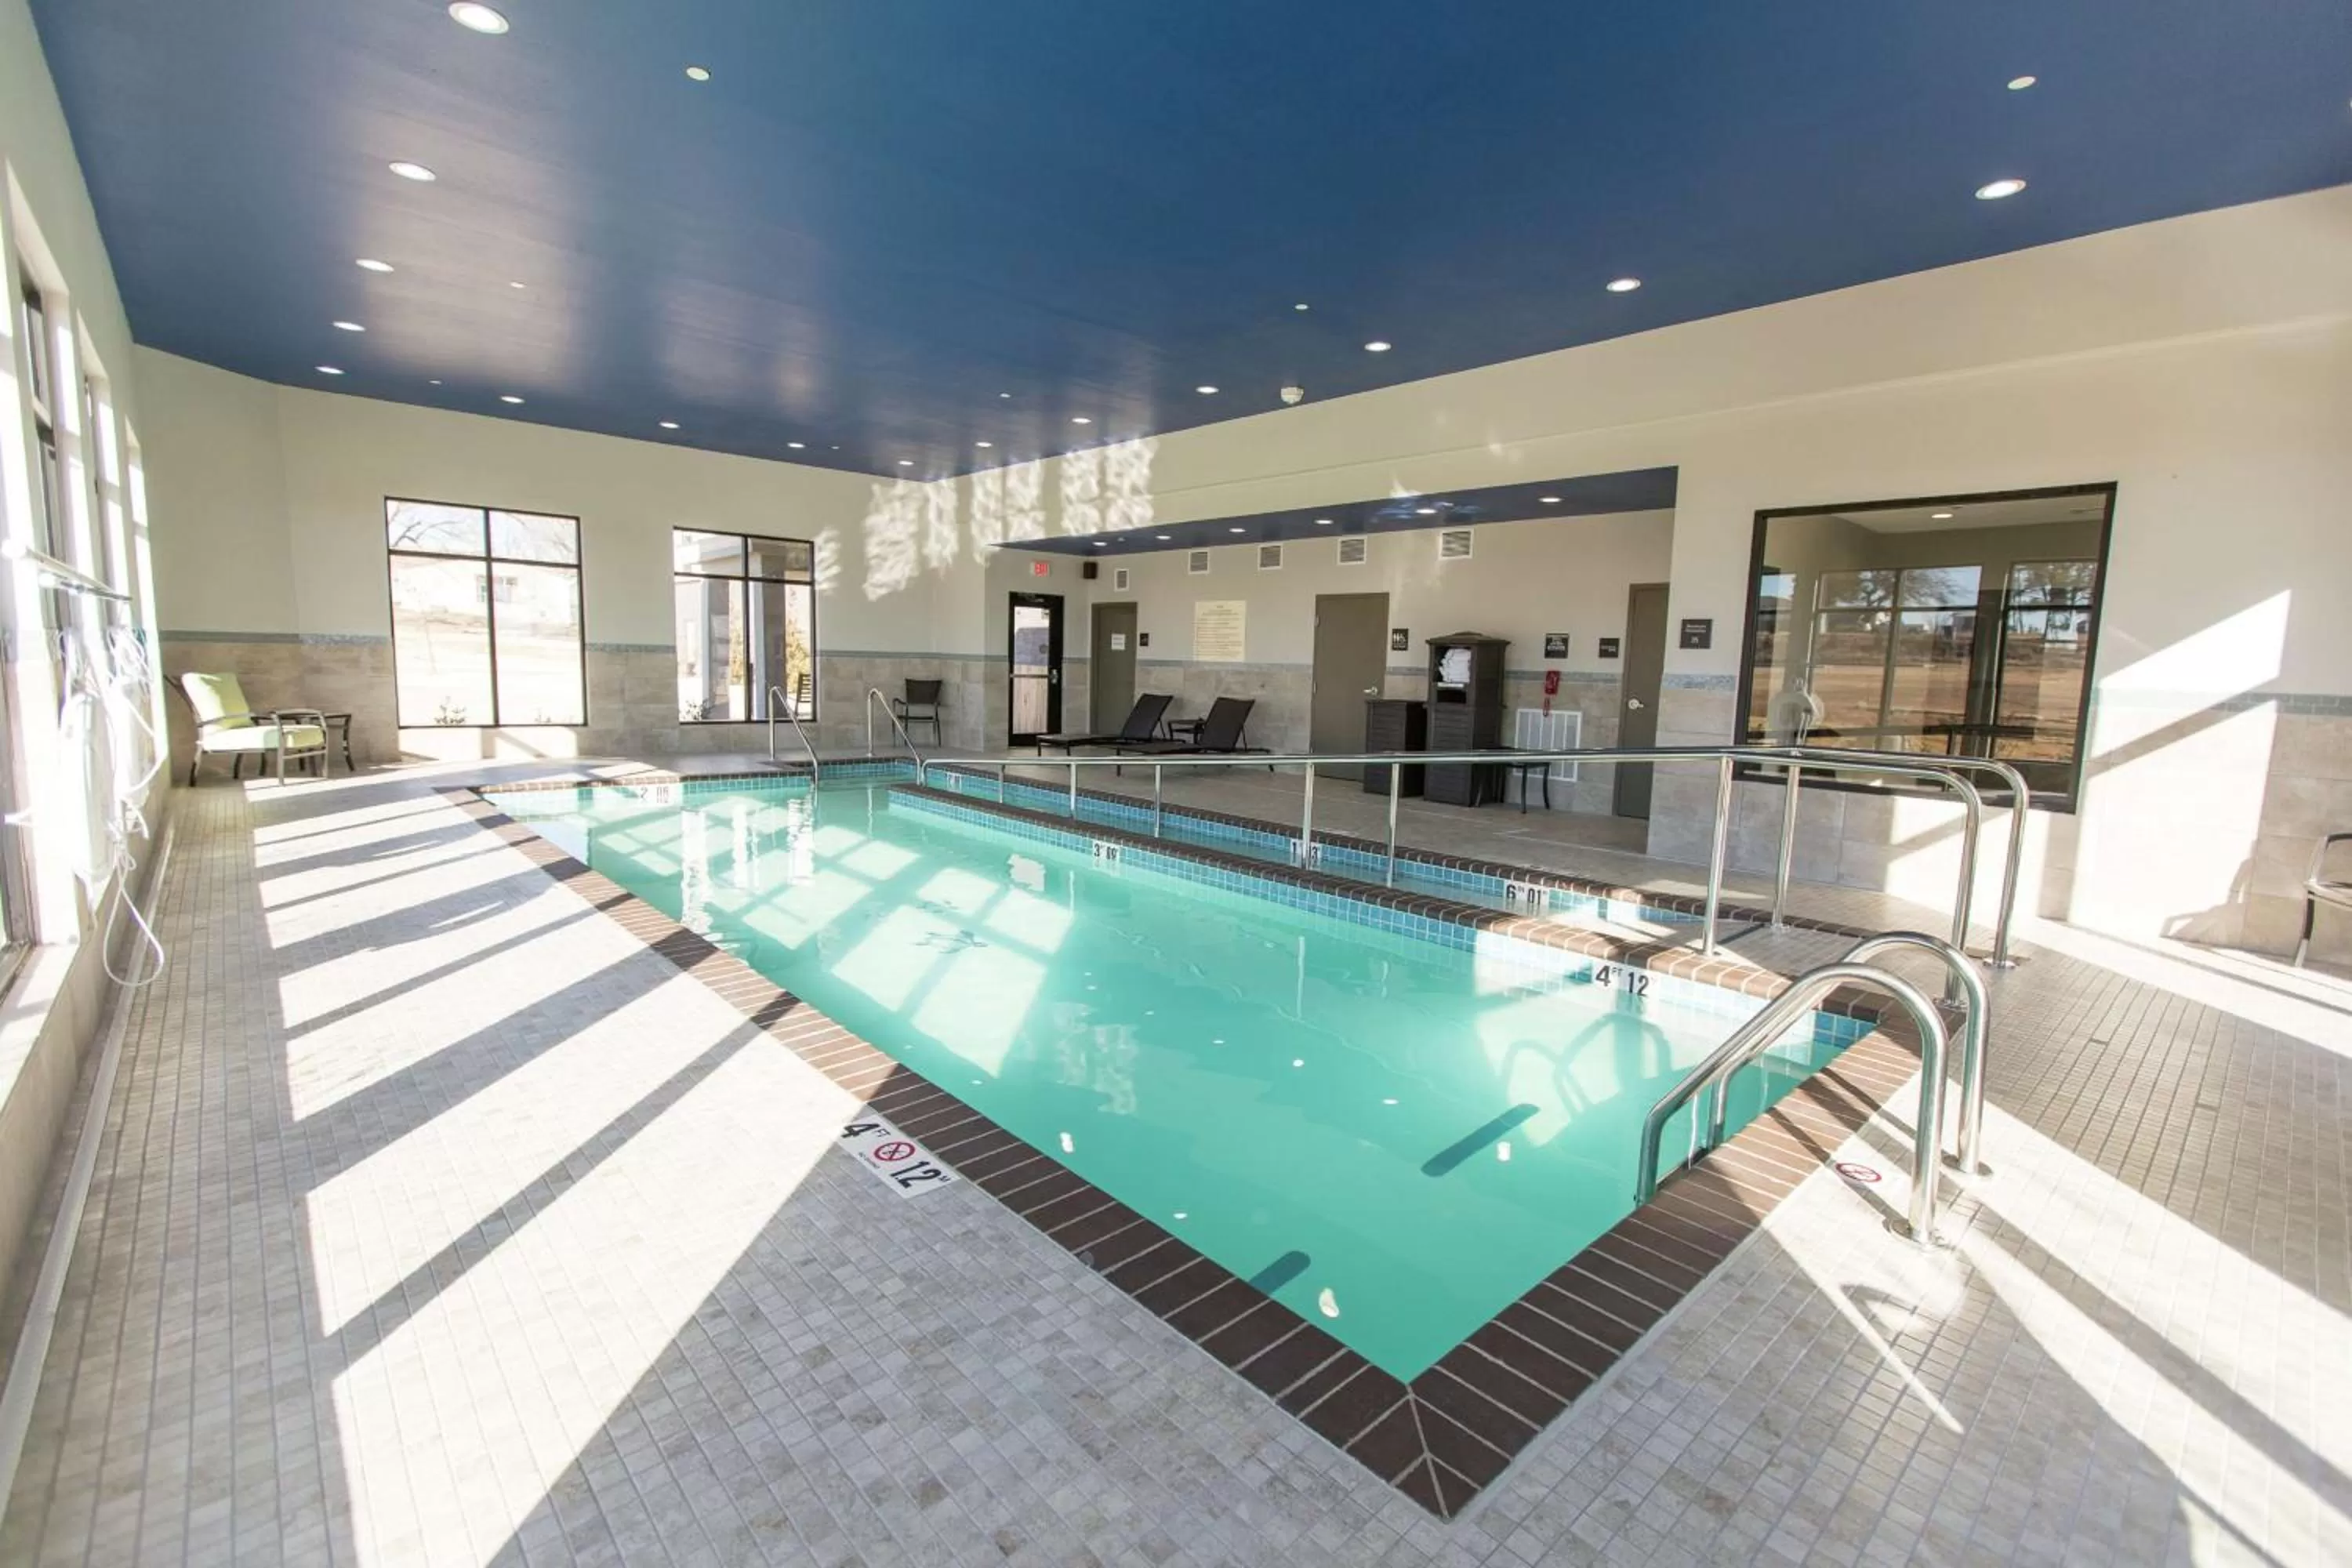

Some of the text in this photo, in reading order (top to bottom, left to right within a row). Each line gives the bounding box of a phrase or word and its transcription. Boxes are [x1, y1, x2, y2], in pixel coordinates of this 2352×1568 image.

[1506, 884, 1516, 898] 6
[1595, 964, 1611, 987] 4
[841, 1122, 881, 1138] 4
